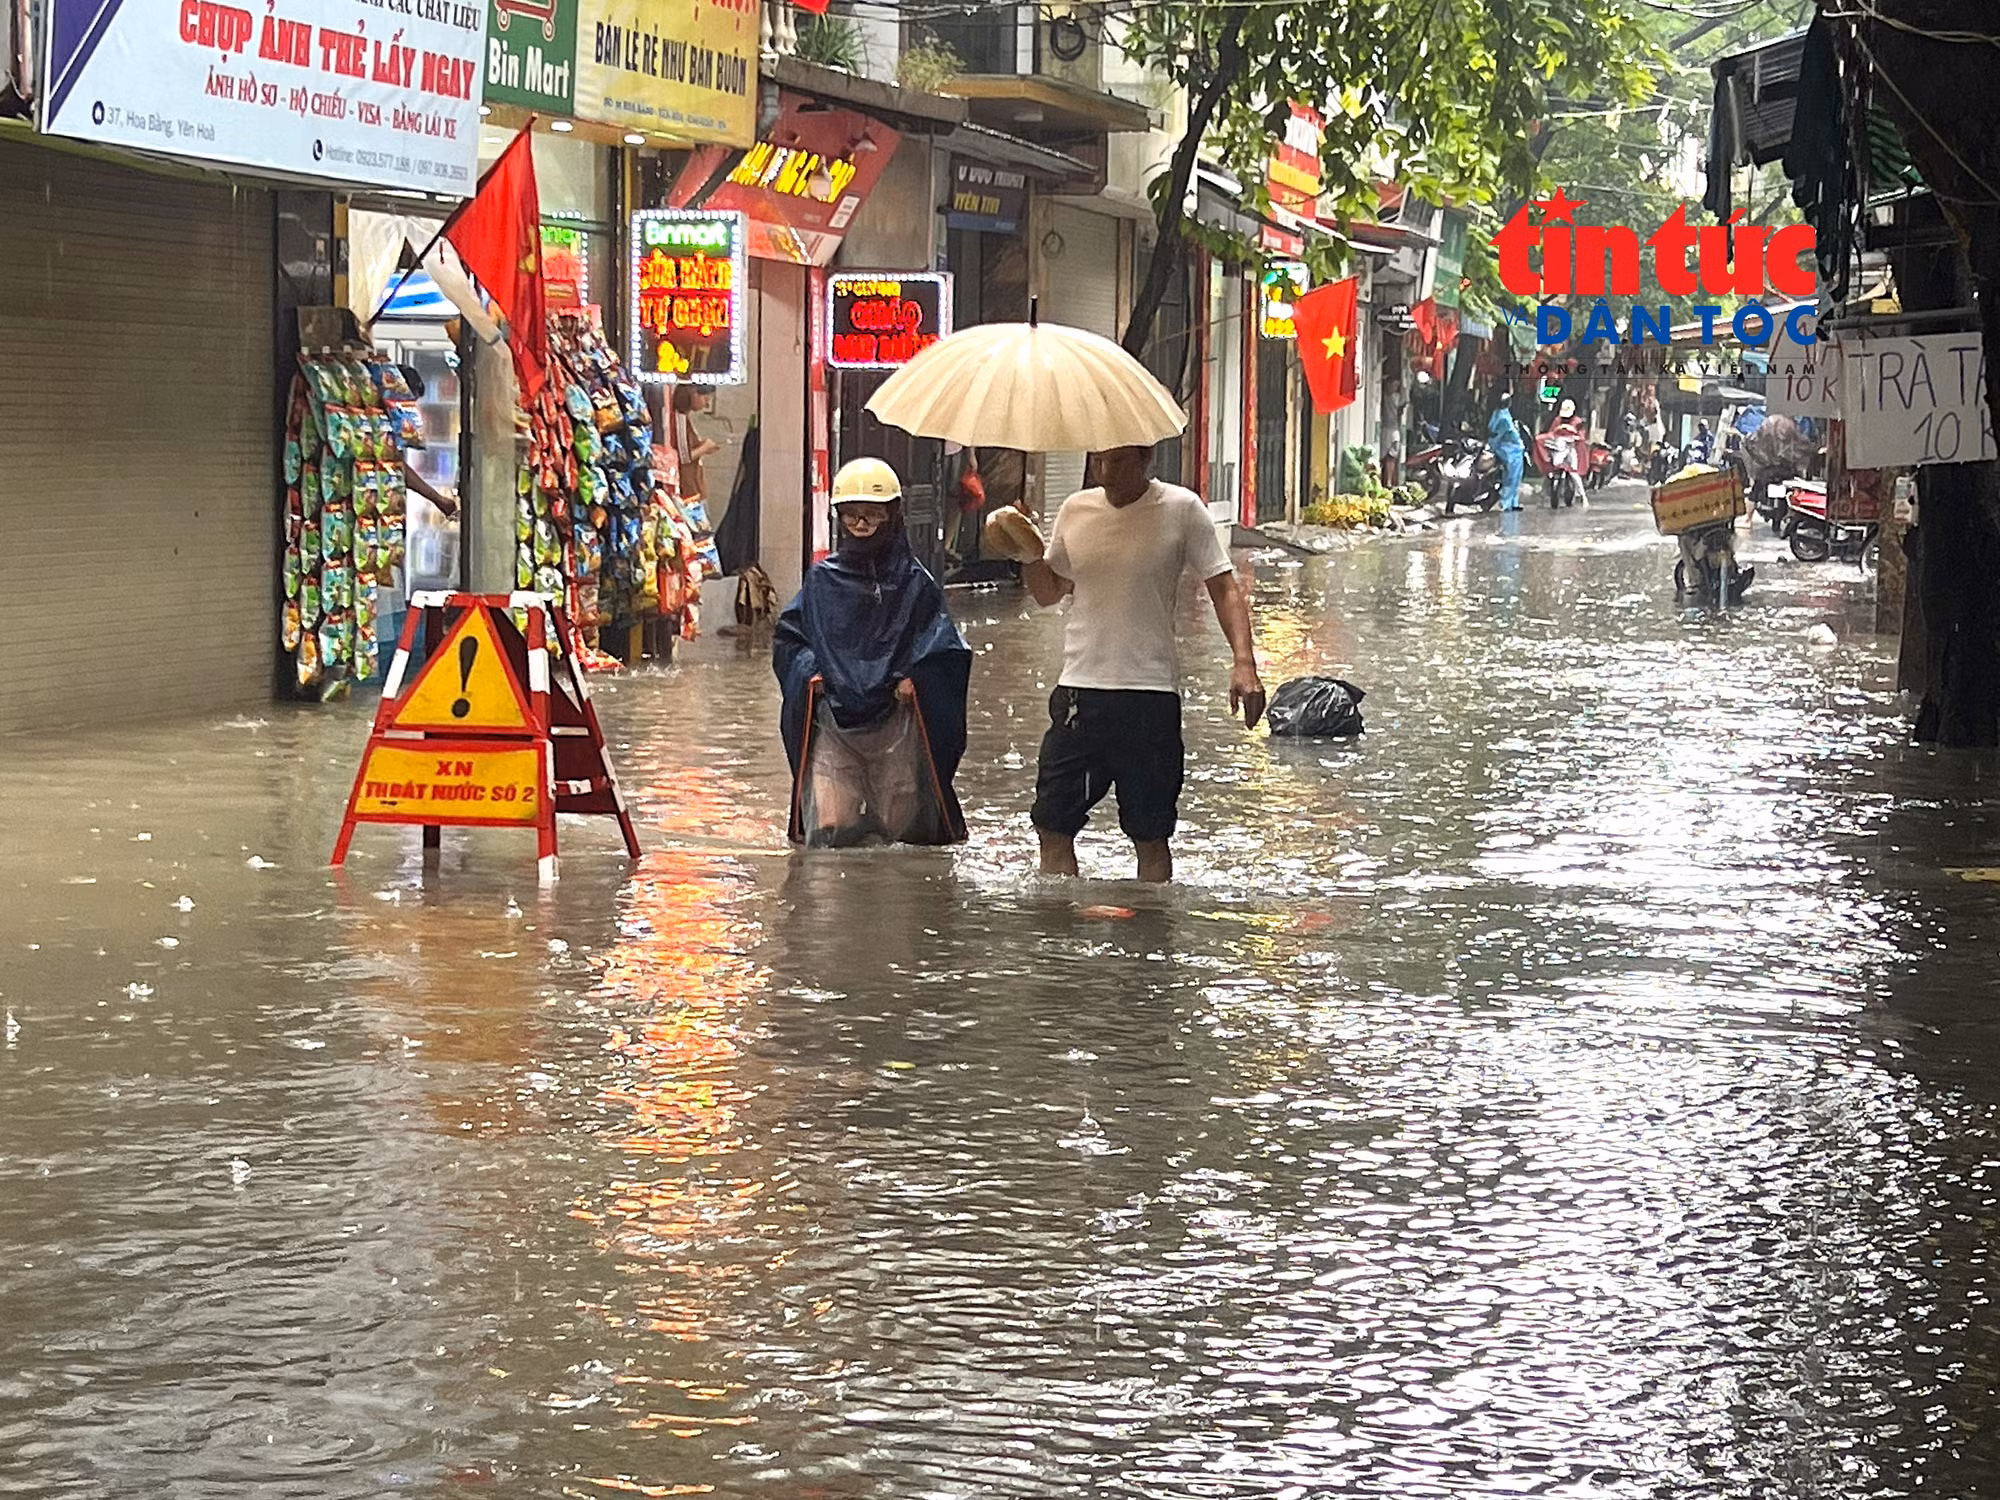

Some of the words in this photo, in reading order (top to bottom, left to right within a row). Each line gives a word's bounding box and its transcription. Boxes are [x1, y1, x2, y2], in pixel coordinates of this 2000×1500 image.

[180, 0, 253, 63] CHỤP
[259, 0, 312, 67] ẢNH
[319, 18, 367, 79] THẺ
[372, 27, 416, 88] LẤY
[420, 51, 476, 100] NGAY
[488, 37, 519, 89] Bin
[524, 45, 570, 99] Mart
[595, 15, 622, 68] BÁN
[625, 17, 639, 72] LẺ
[662, 38, 688, 83] NHƯ
[689, 39, 714, 89] BÁN
[716, 47, 747, 96] BUÔN
[126, 112, 146, 130] Hoa
[205, 65, 234, 99] ẢNH
[311, 86, 347, 120] CHIẾU
[358, 101, 382, 126] VISA
[444, 118, 457, 140] XE
[1786, 374, 1813, 402] 10
[1821, 377, 1838, 402] K
[1848, 339, 1937, 413] TRÀ
[1914, 411, 1961, 462] 10
[431, 781, 486, 801] NƯỚC
[491, 781, 517, 802] SỐ
[522, 786, 535, 803] 2
[436, 760, 474, 777] XN
